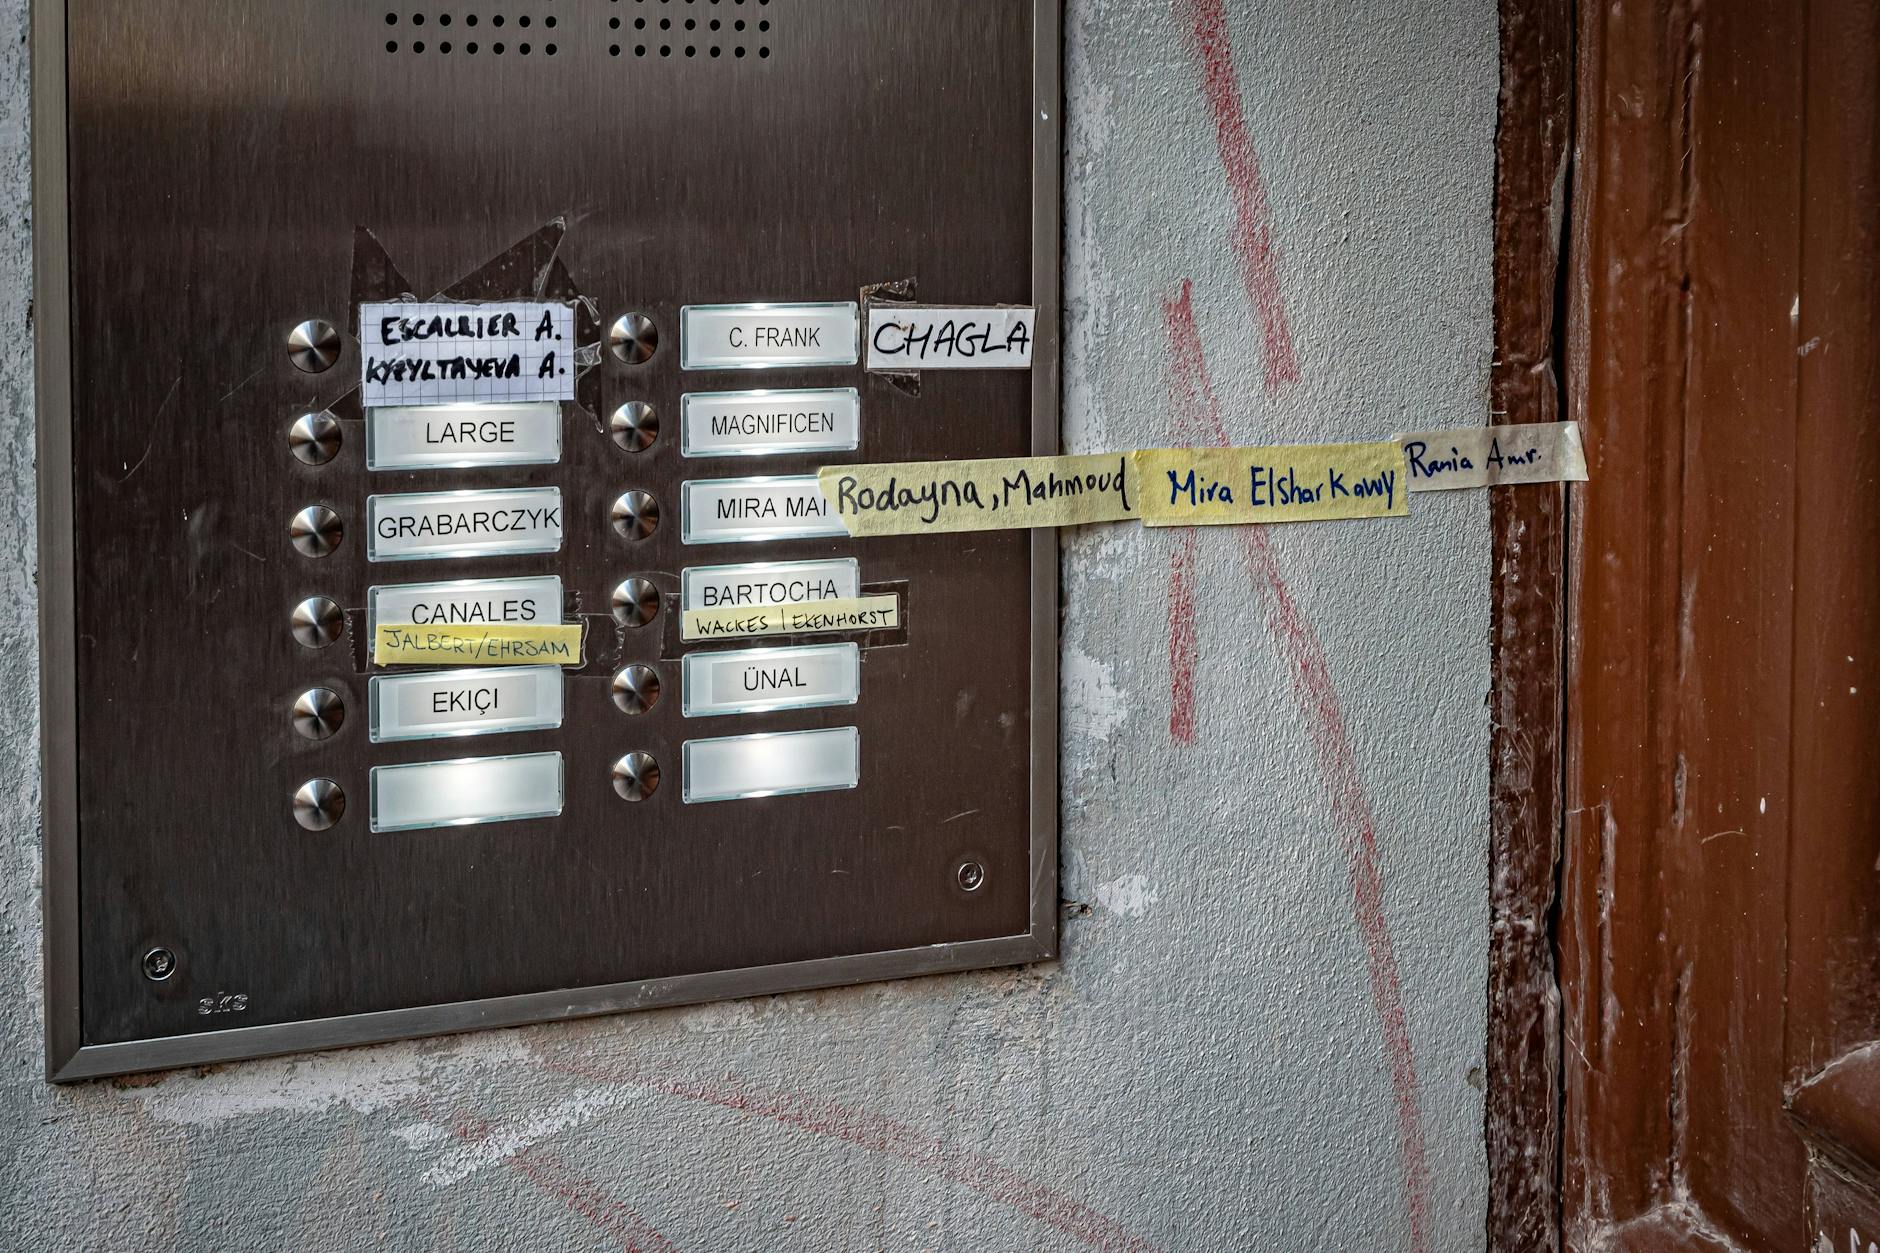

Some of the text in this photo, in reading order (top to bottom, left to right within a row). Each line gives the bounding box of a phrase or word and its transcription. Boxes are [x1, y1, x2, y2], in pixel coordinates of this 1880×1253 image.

[534, 310, 562, 341] A.
[729, 326, 821, 348] C. FRANK
[873, 320, 1030, 359] CHAGLA
[538, 351, 565, 379] A.
[426, 421, 515, 443] LARGE
[711, 412, 834, 436] MAGNIFICEN
[1404, 441, 1474, 478] Rania
[1001, 456, 1131, 512] Mahmoud
[1168, 469, 1234, 507] Mira
[717, 498, 777, 519] MIRA
[377, 507, 560, 539] GRABARCZYK
[703, 579, 838, 606] BARTOCHA
[411, 600, 536, 625] CANALES
[696, 615, 769, 635] WACKES
[743, 666, 807, 691] ÜNAL
[432, 688, 499, 716] EKIÇI
